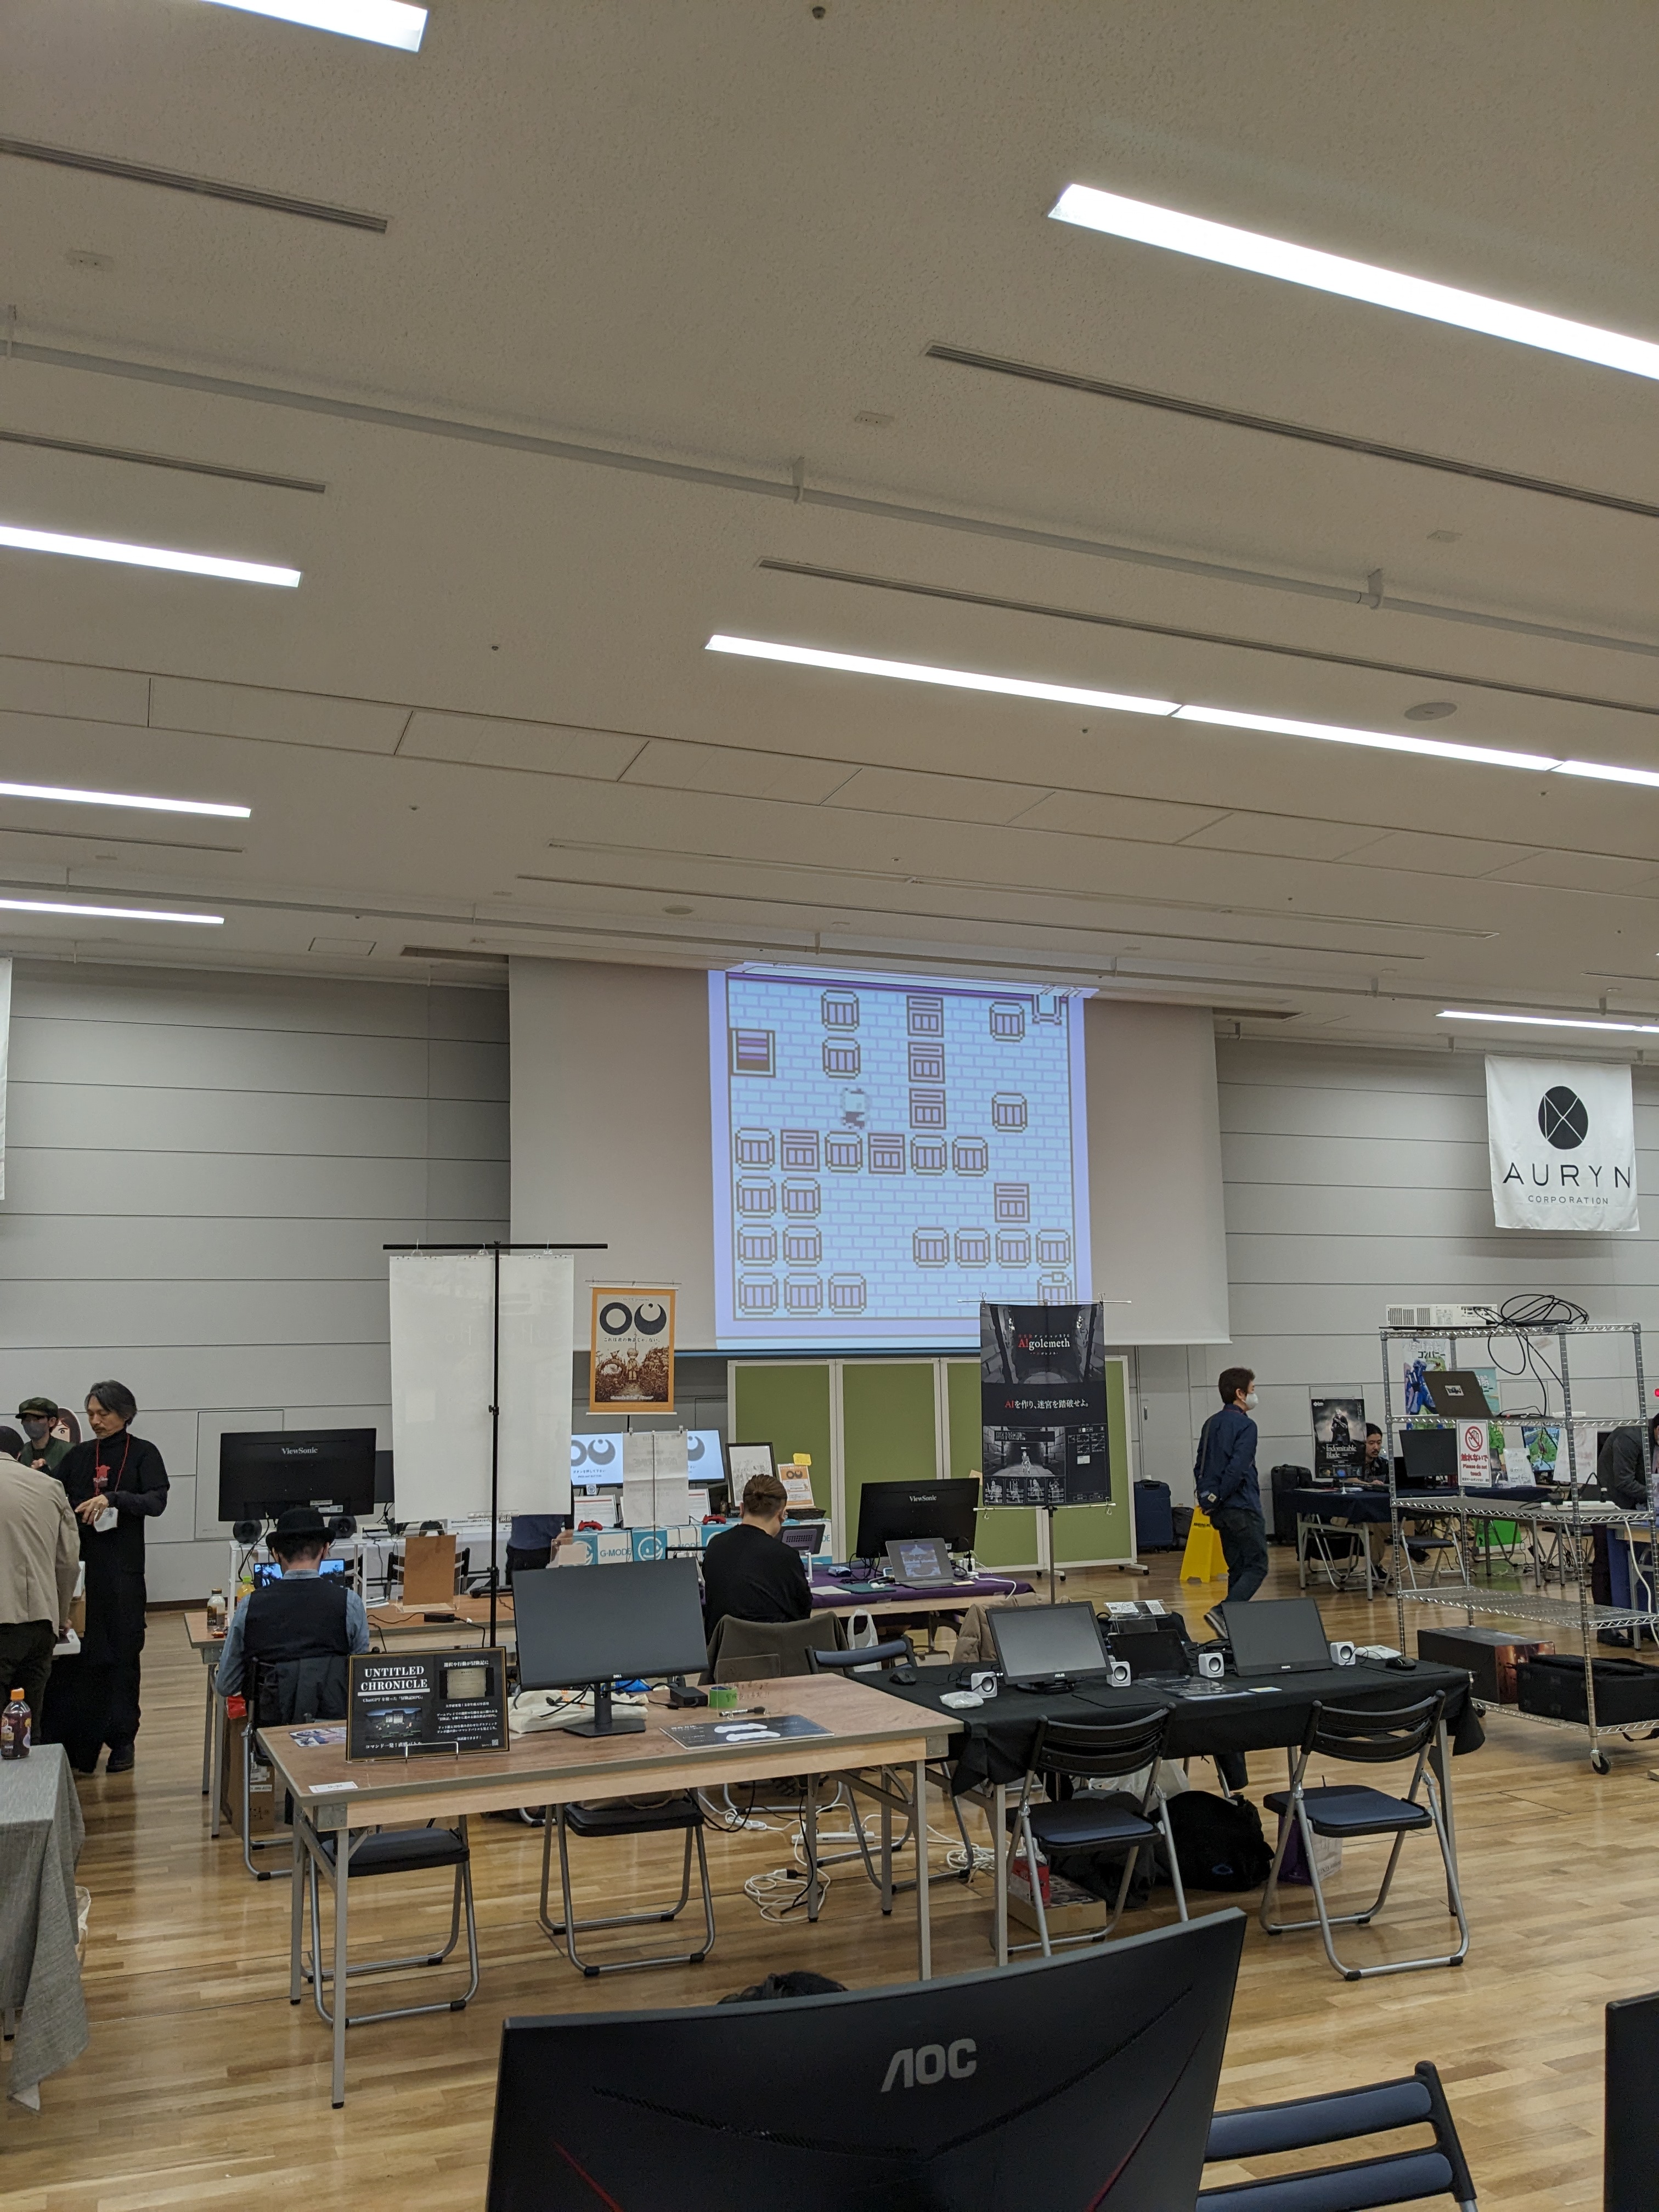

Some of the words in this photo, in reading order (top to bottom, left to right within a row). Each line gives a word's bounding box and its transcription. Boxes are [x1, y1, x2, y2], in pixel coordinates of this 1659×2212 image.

[1502, 1162, 1630, 1188] AURYN
[1528, 1195, 1609, 1204] CORPORATION
[1005, 1399, 1089, 1409] AIを作り、迷宮を踏破せよ。
[1461, 1453, 1488, 1462] 触れないで
[600, 1548, 631, 1558] G-MODE
[364, 1666, 425, 1678] UNTITLED
[360, 1679, 428, 1691] CHRONICLE
[881, 2038, 977, 2093] AOC
